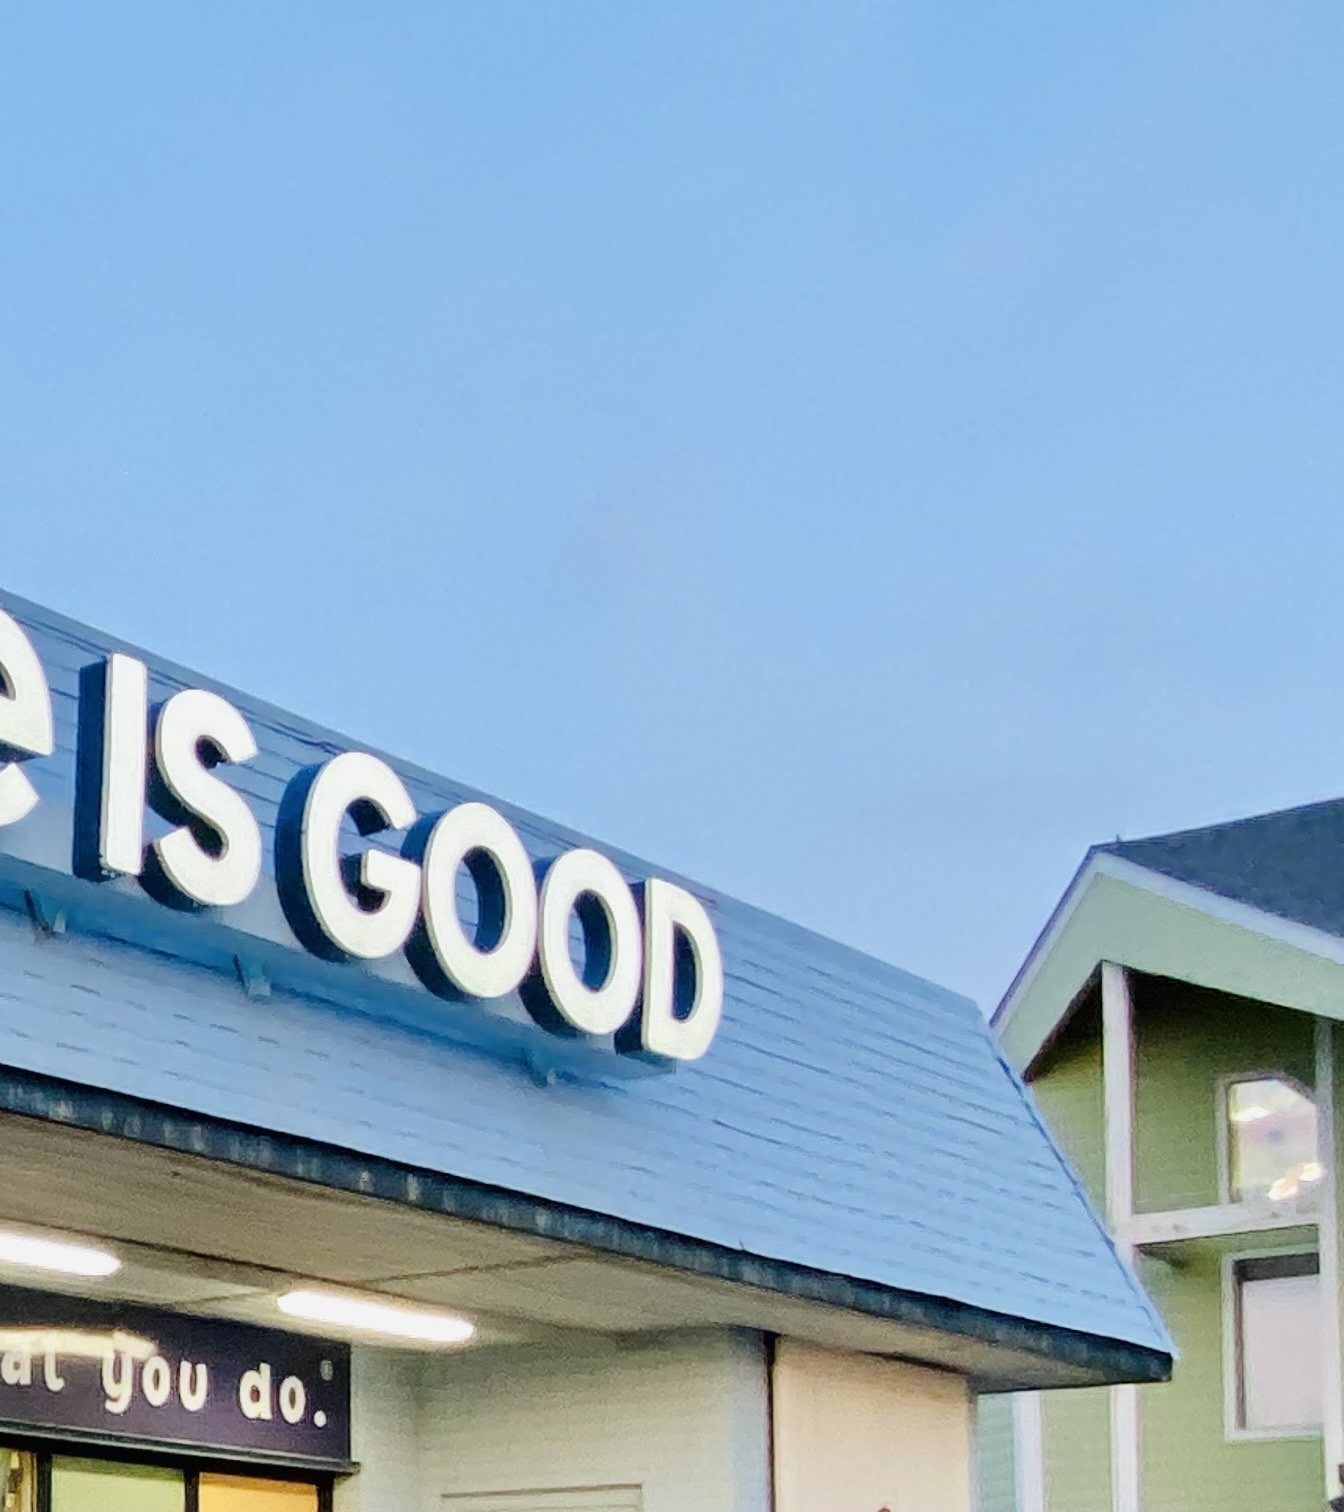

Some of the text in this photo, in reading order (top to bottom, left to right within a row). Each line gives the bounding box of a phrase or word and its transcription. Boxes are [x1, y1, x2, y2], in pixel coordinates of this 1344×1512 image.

[84, 652, 262, 910] IS
[286, 751, 724, 1062] GOOD
[101, 1331, 210, 1415] you
[239, 1362, 329, 1428] do.
